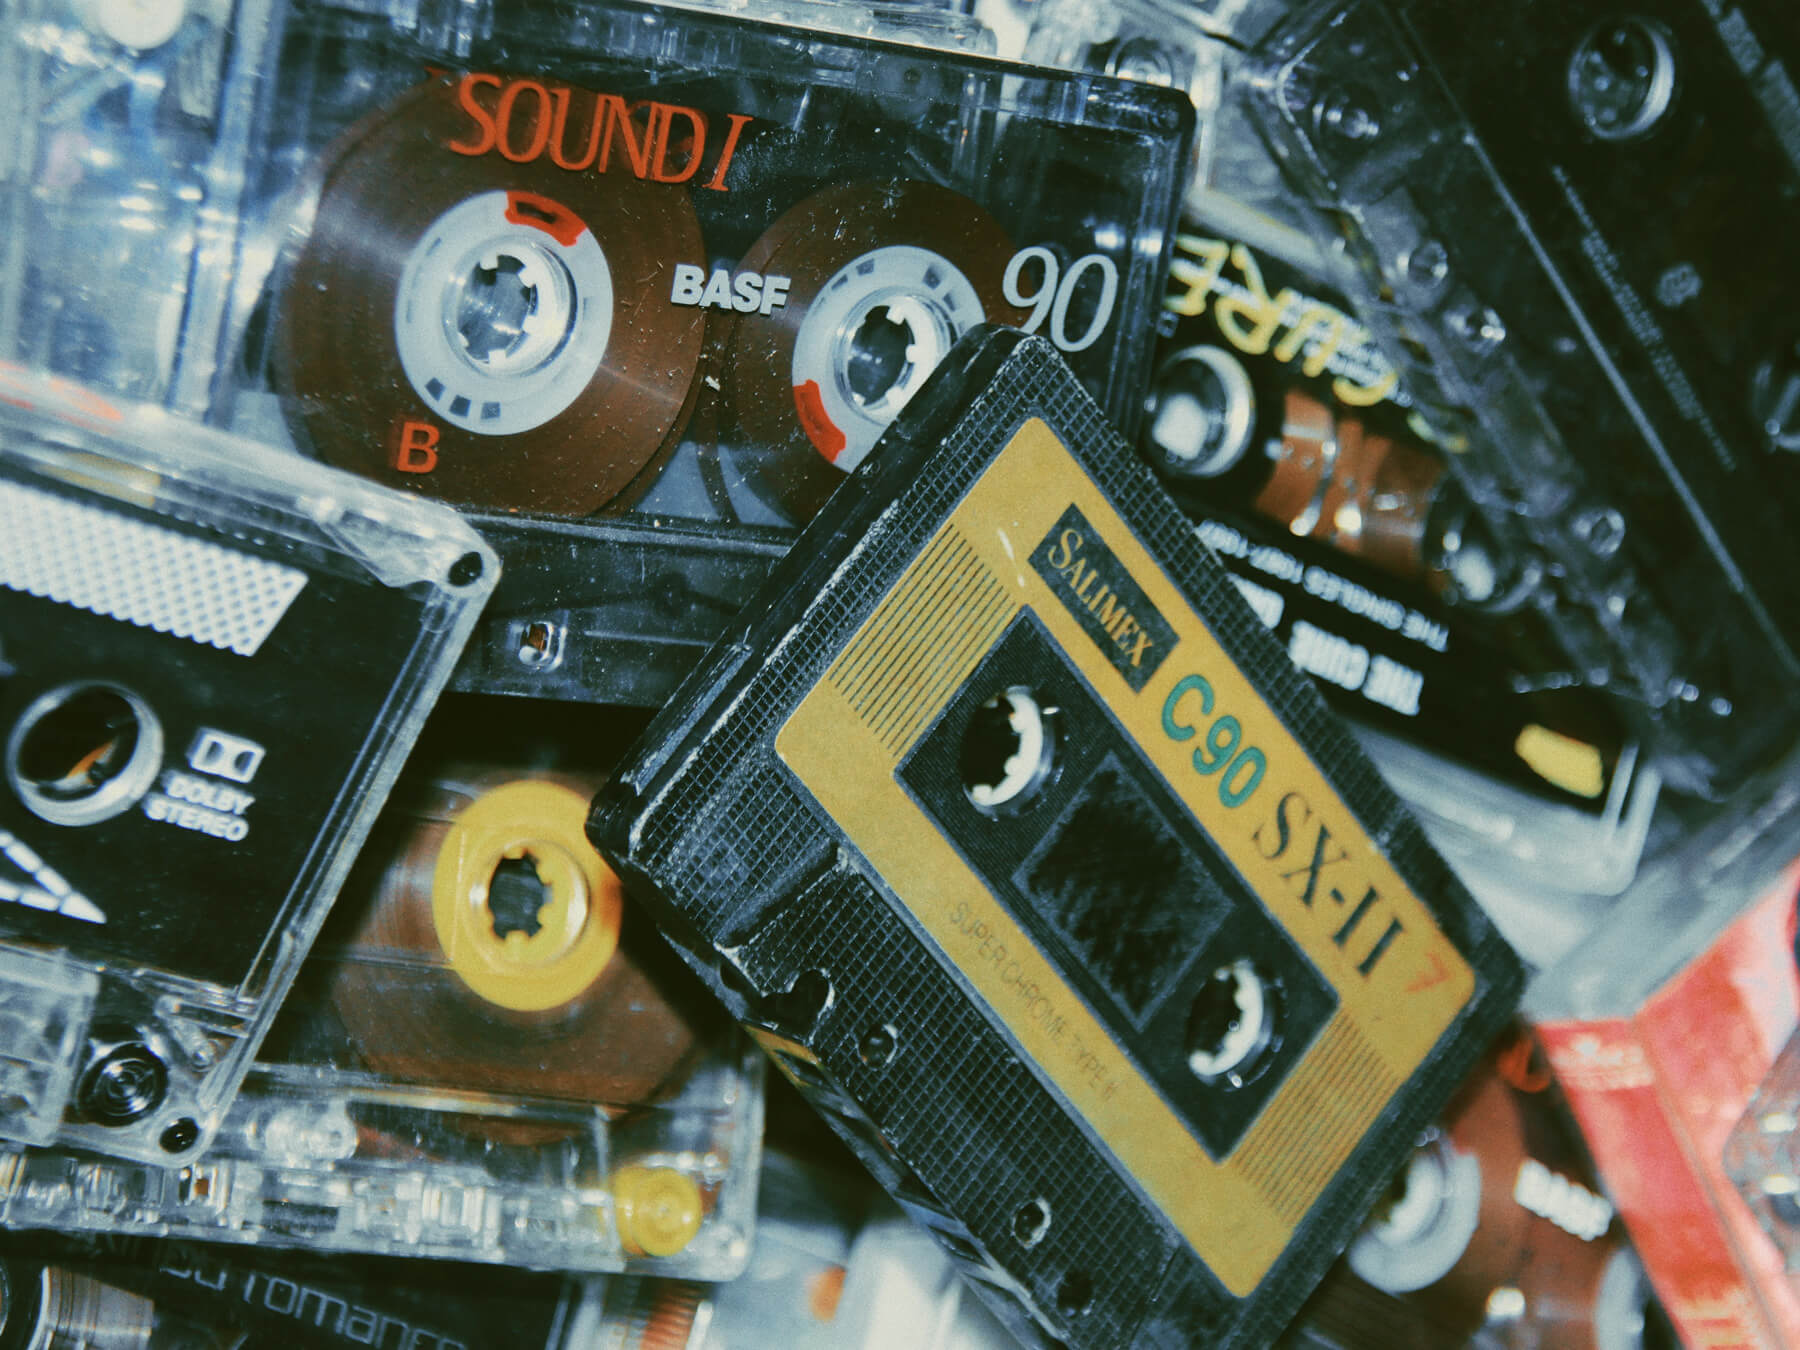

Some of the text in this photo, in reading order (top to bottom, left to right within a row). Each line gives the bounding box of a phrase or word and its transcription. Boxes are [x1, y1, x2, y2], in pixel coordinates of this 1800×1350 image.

[449, 72, 754, 192] SOUND I
[671, 262, 792, 316] BASF
[1002, 245, 1119, 353] 90
[397, 421, 440, 474] B
[1047, 527, 1156, 670] SALIMEX
[144, 793, 250, 842] STEREO
[163, 772, 257, 816] DOLBY
[1160, 673, 1268, 809] C90
[1251, 790, 1407, 979] SX-II
[951, 901, 1009, 968] SUPER
